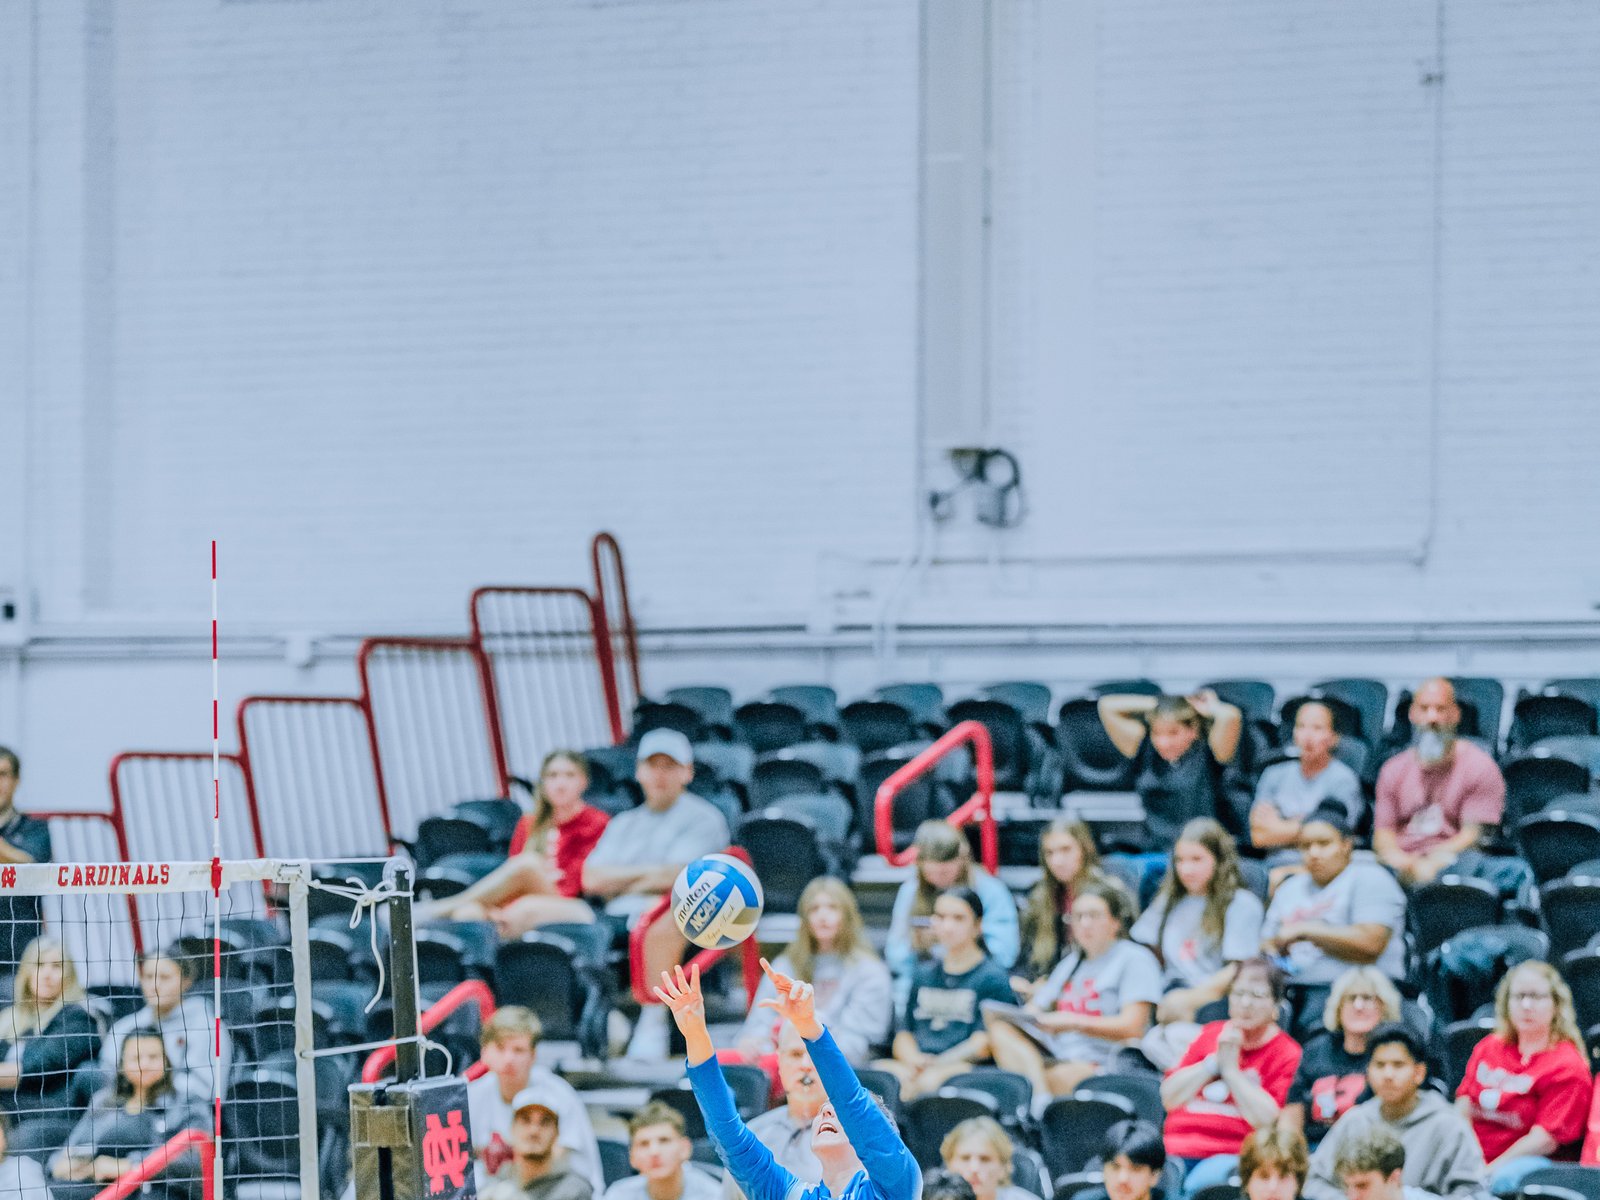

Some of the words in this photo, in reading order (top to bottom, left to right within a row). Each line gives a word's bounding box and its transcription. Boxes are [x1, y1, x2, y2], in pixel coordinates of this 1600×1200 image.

[57, 864, 170, 887] CARDINALS
[677, 881, 712, 924] molten
[689, 892, 723, 933] NCAA
